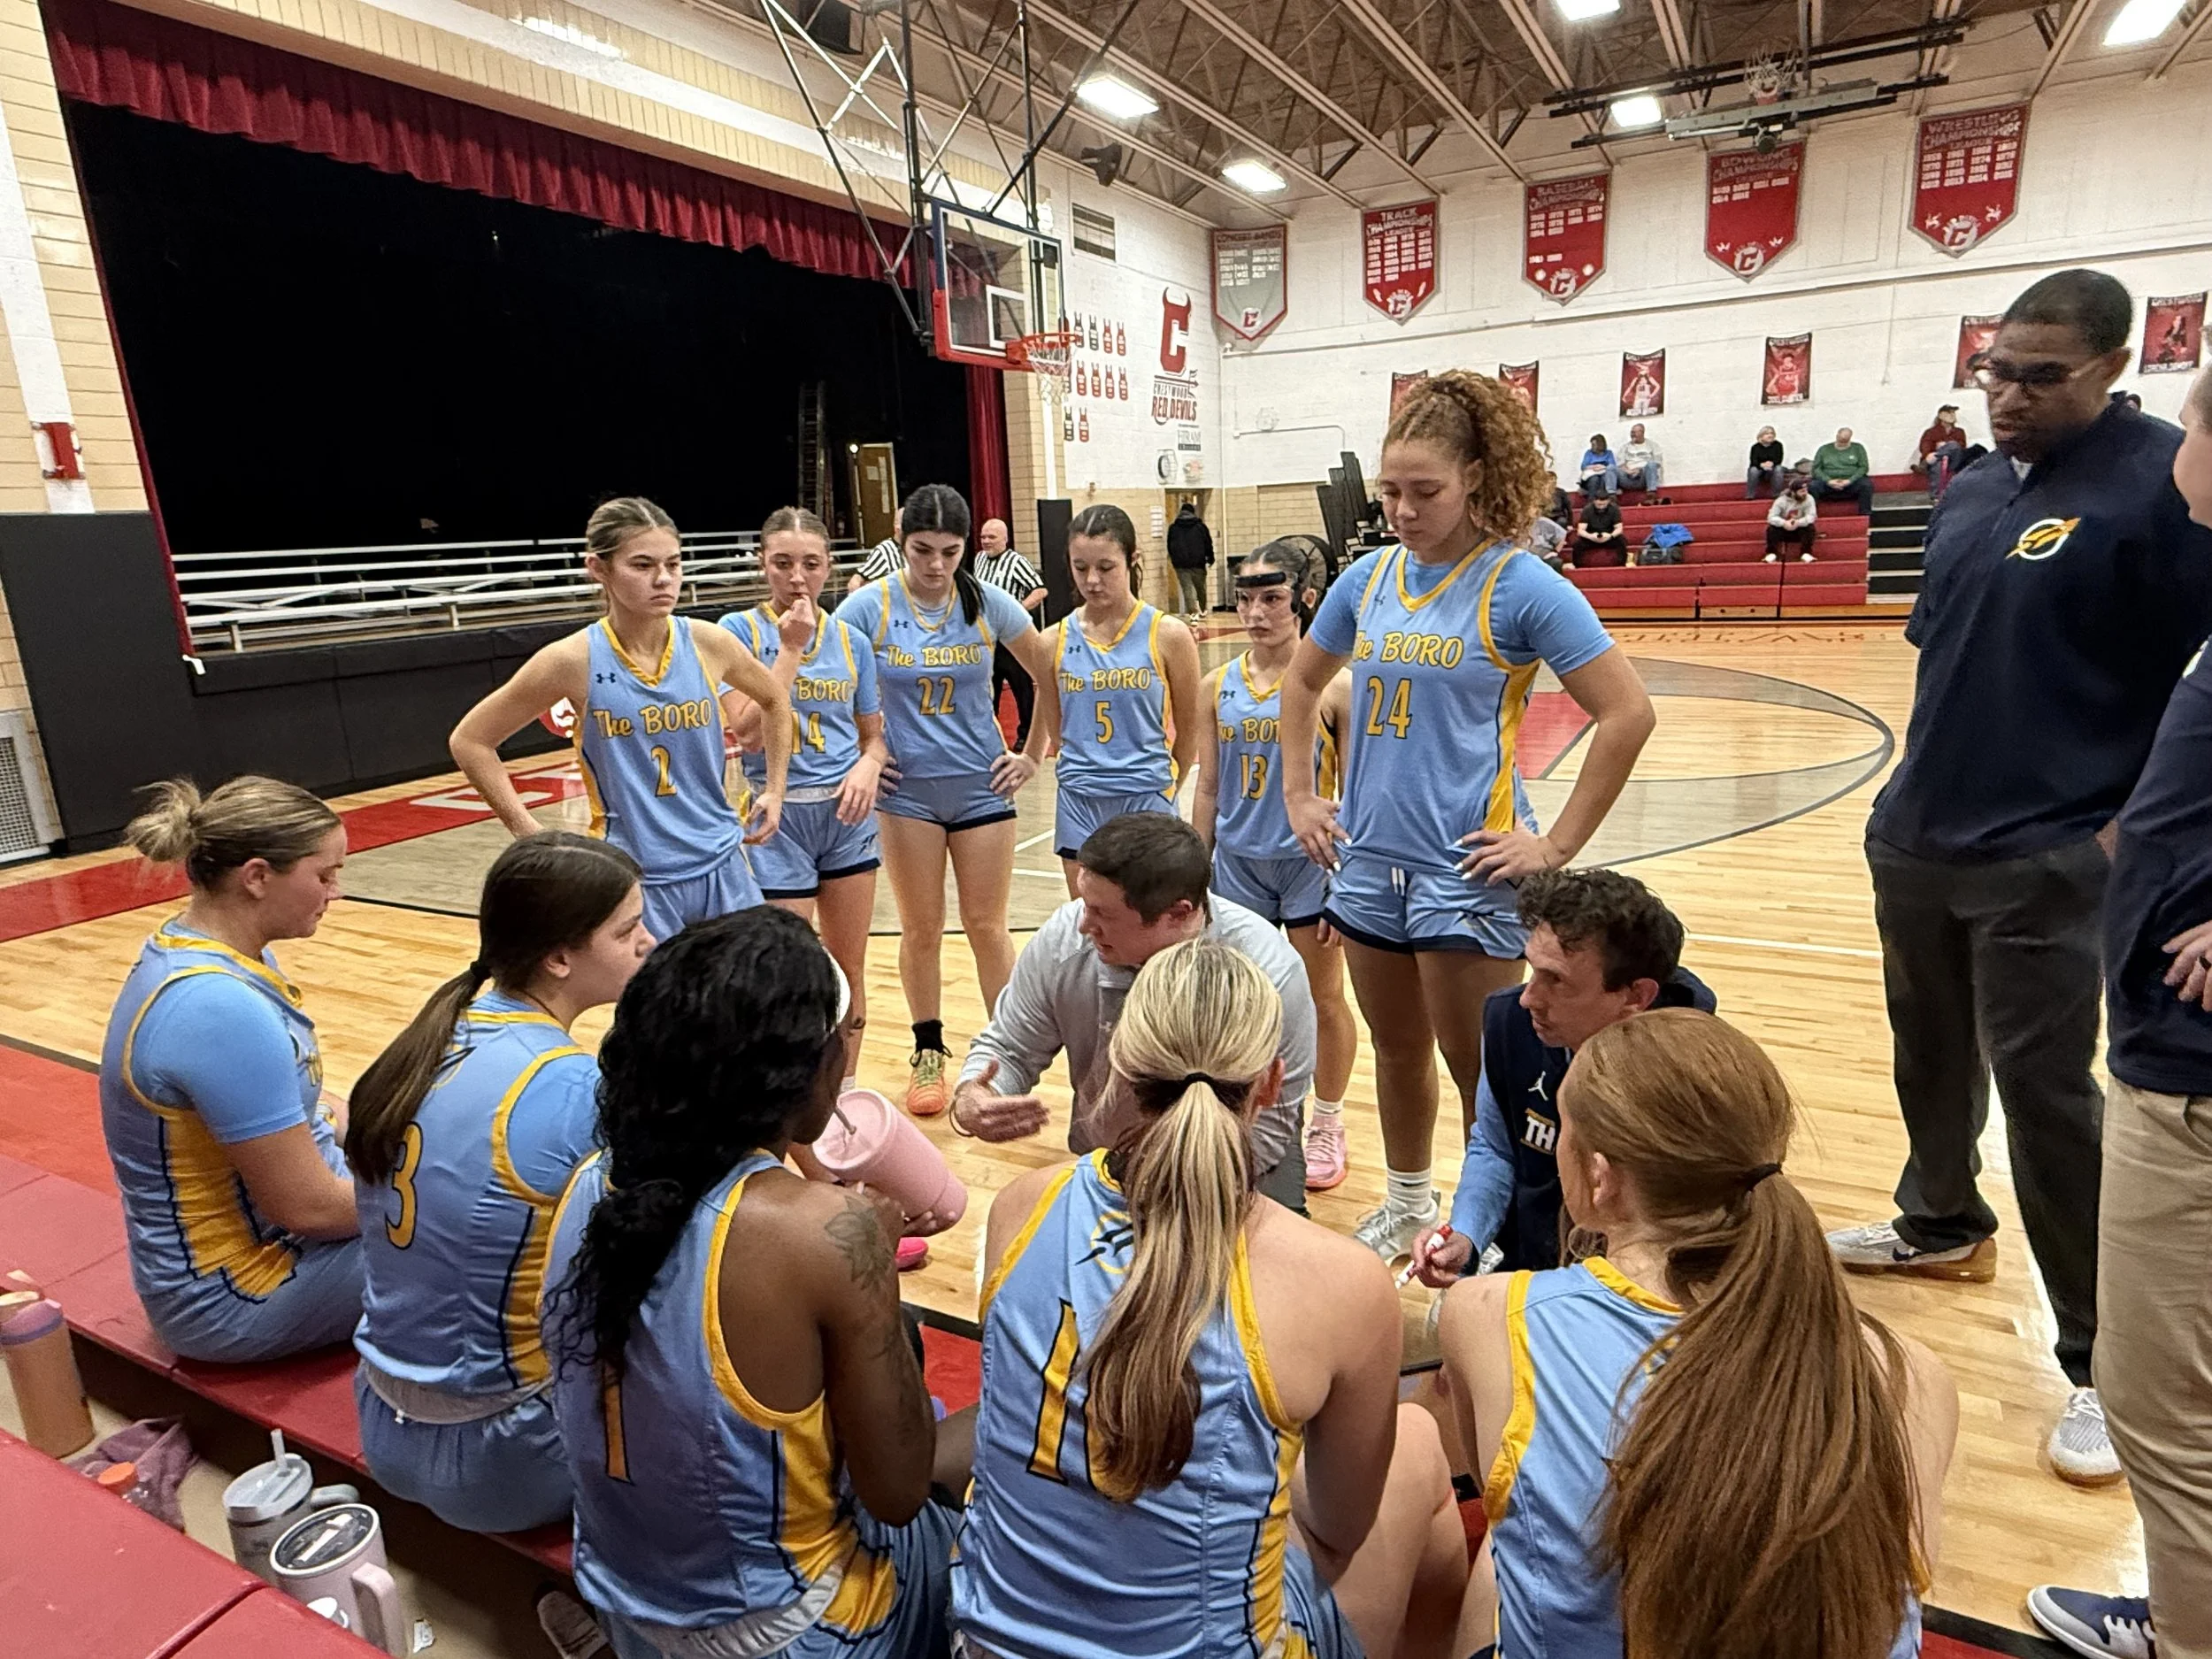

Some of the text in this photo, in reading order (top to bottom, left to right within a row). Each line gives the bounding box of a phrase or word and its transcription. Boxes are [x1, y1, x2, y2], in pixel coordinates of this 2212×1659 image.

[1924, 120, 2022, 150] CHAMPIONSHIPS
[1366, 214, 1433, 239] CHAMPIONSHIPS
[1380, 207, 1417, 222] TRACK
[1151, 396, 1197, 421] RED DEVILS
[887, 643, 982, 668] The BORO
[1379, 631, 1464, 670] BORO
[916, 675, 956, 716] 22
[1059, 666, 1151, 694] The BORO
[593, 697, 712, 739] The BORO
[1094, 701, 1114, 744] 5
[1366, 675, 1413, 739] 24
[792, 710, 826, 755] 14
[650, 745, 678, 797] 2
[1239, 753, 1268, 801] 13
[384, 1121, 424, 1249] 3
